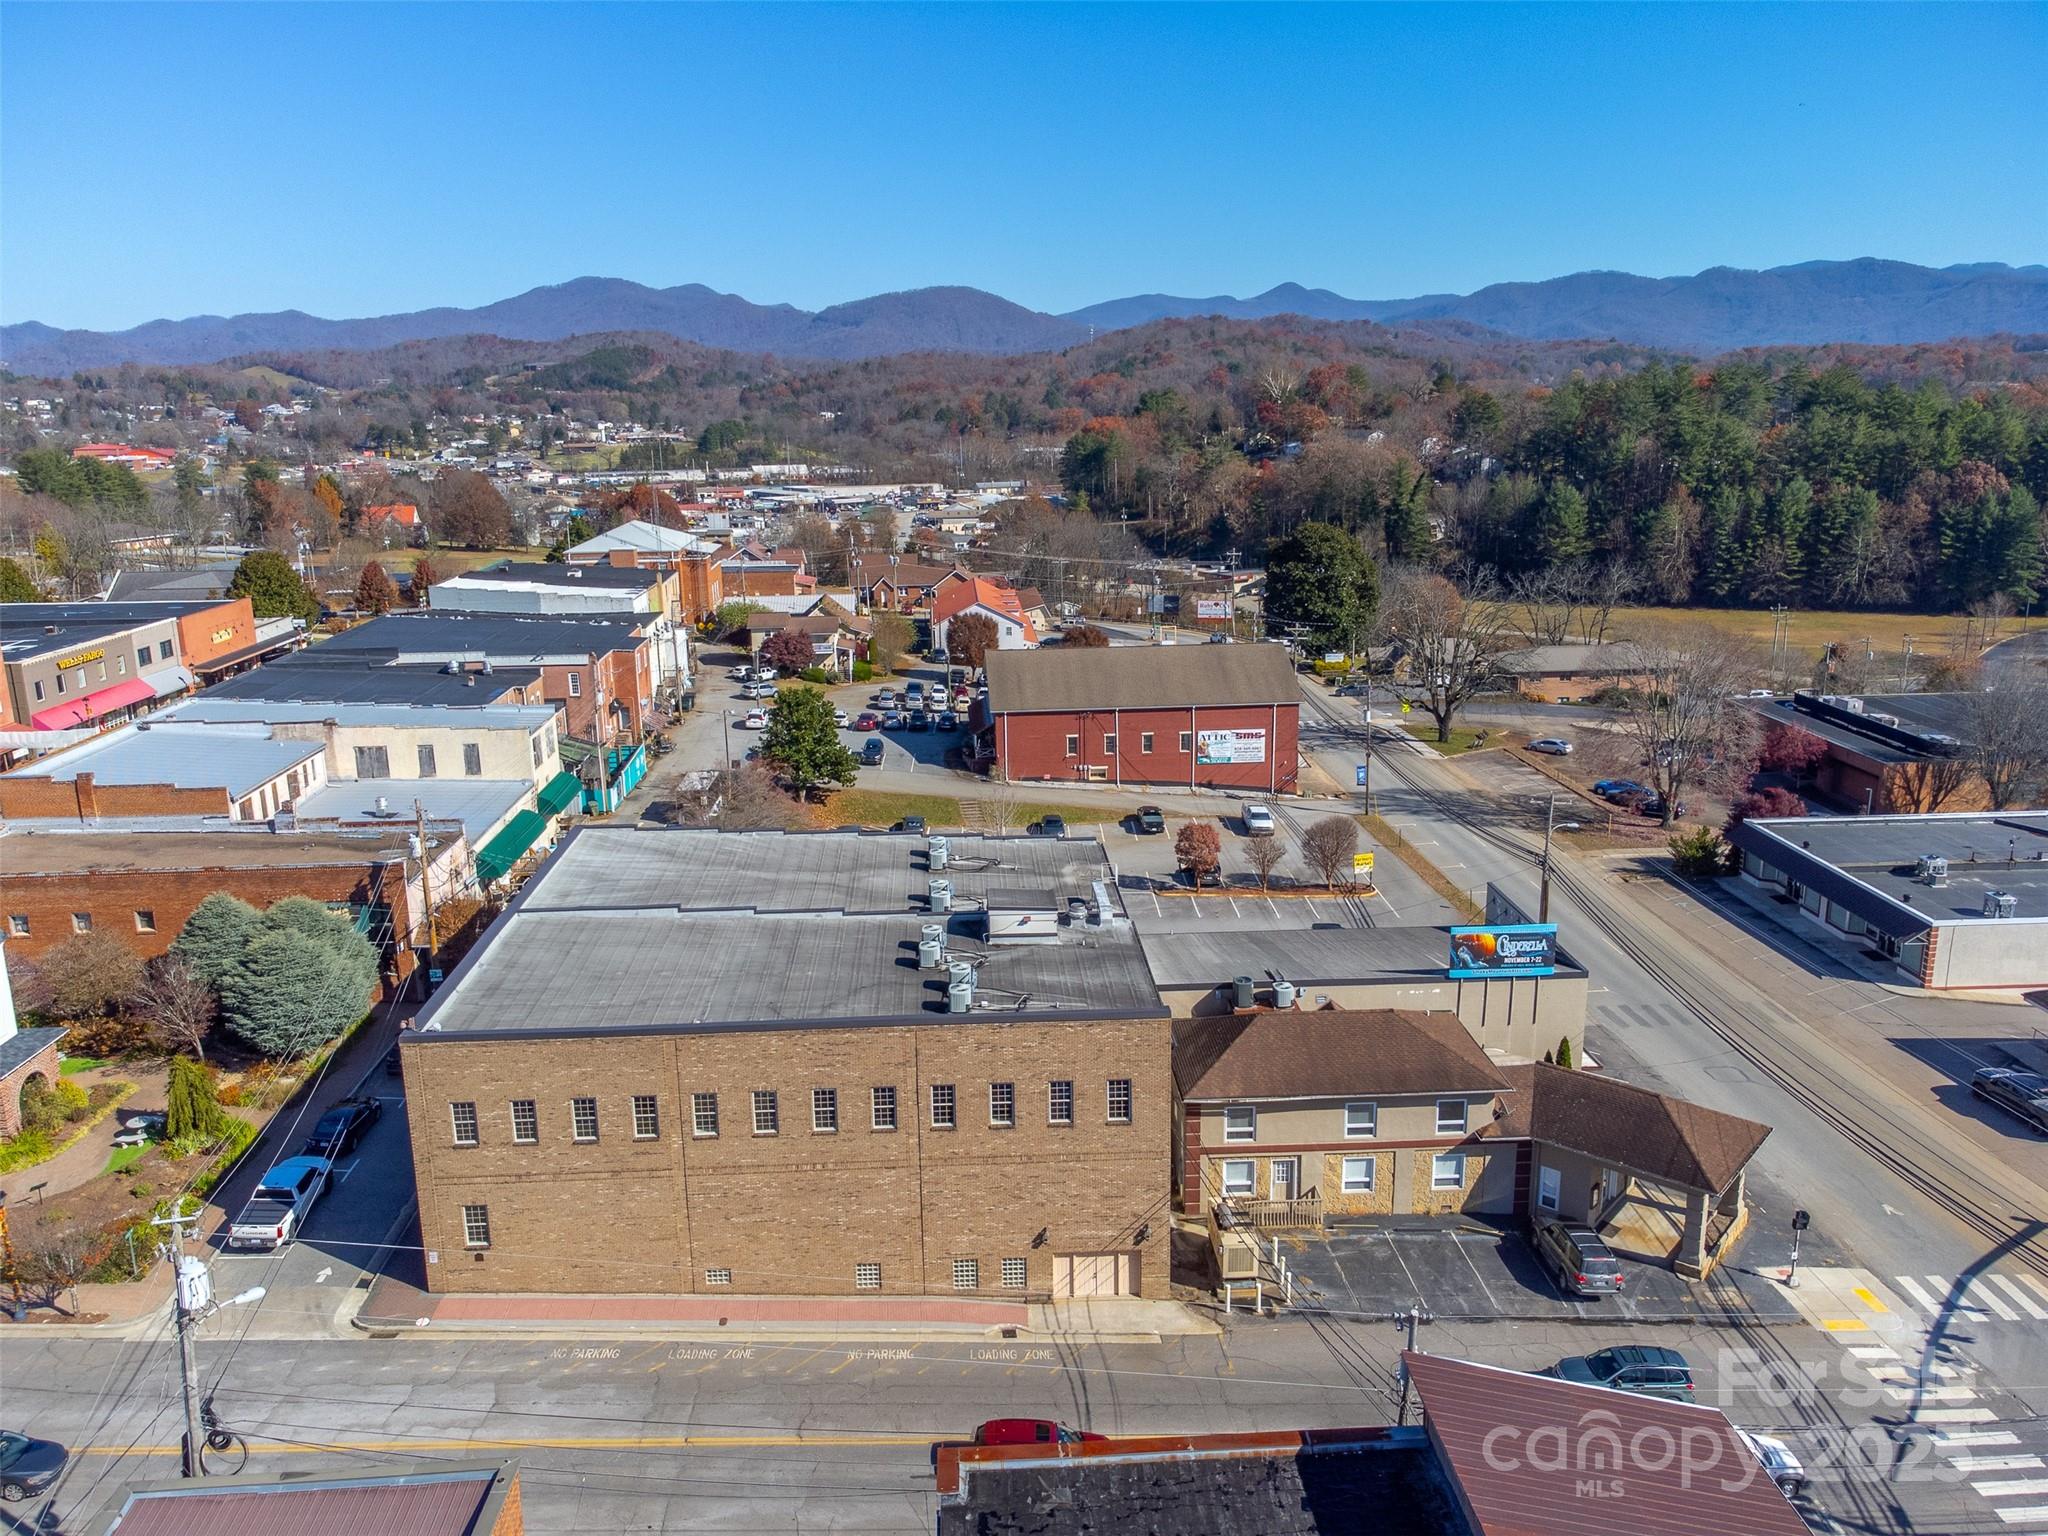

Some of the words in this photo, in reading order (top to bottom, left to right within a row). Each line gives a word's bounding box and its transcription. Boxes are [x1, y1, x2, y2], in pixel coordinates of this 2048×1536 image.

[58, 656, 83, 670] WELLS
[83, 649, 105, 661] FARGO
[551, 1349, 567, 1359] NO
[571, 1349, 621, 1359] PARKING
[668, 1350, 718, 1359] LOADING
[723, 1350, 755, 1359] ZONE
[848, 1350, 862, 1359] NO
[867, 1350, 915, 1359] PARKING
[970, 1350, 1018, 1360] LOADING
[1025, 1350, 1055, 1360] ZONE
